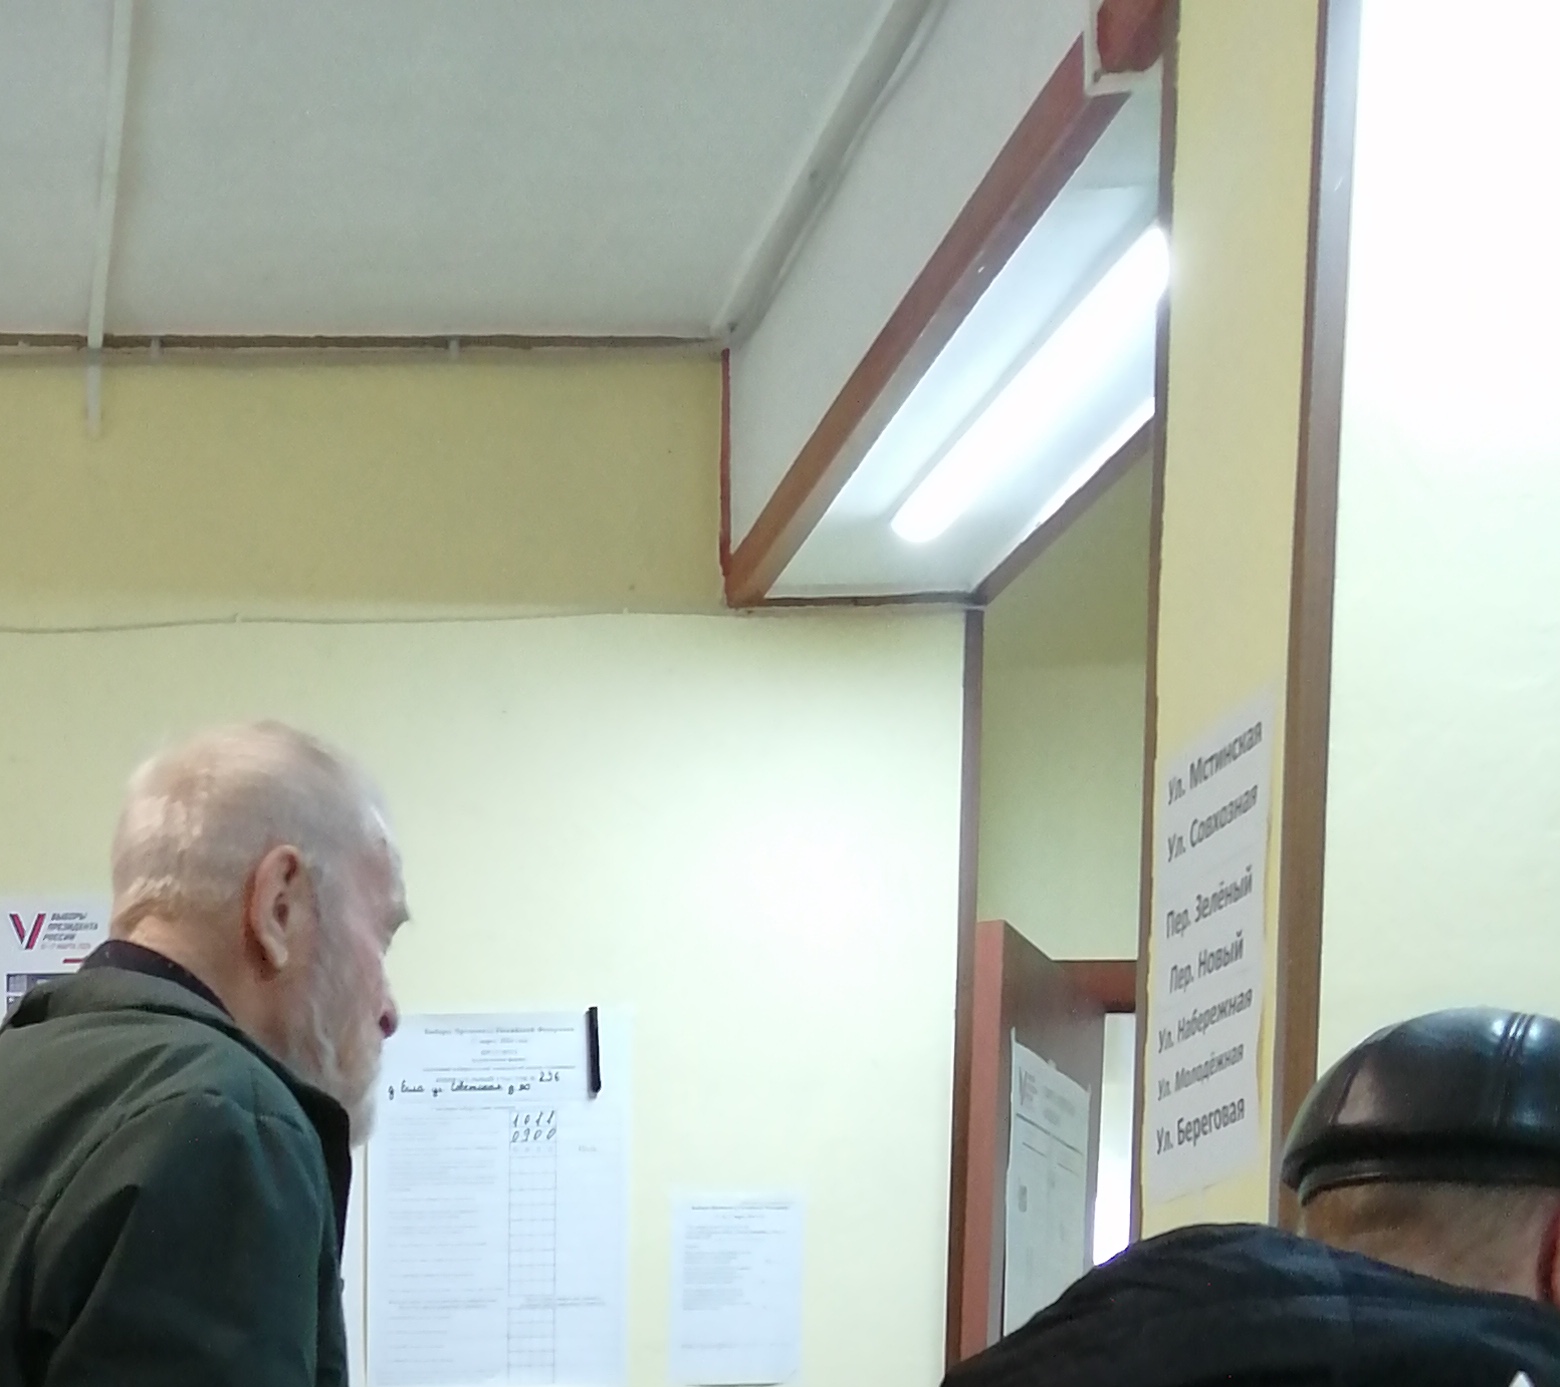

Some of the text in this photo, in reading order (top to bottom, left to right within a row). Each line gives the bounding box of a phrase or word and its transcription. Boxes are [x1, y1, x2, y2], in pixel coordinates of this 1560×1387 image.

[1168, 777, 1186, 806] Ул.
[1168, 784, 1258, 863] Ул. Совхозная
[1166, 865, 1253, 939] Пер. Зелёный
[1170, 930, 1244, 994] Пер. Новый
[1158, 988, 1253, 1054] Ул. Набережная
[1158, 1078, 1172, 1101] Ул.
[1157, 1098, 1246, 1155] Ул. Береговая
